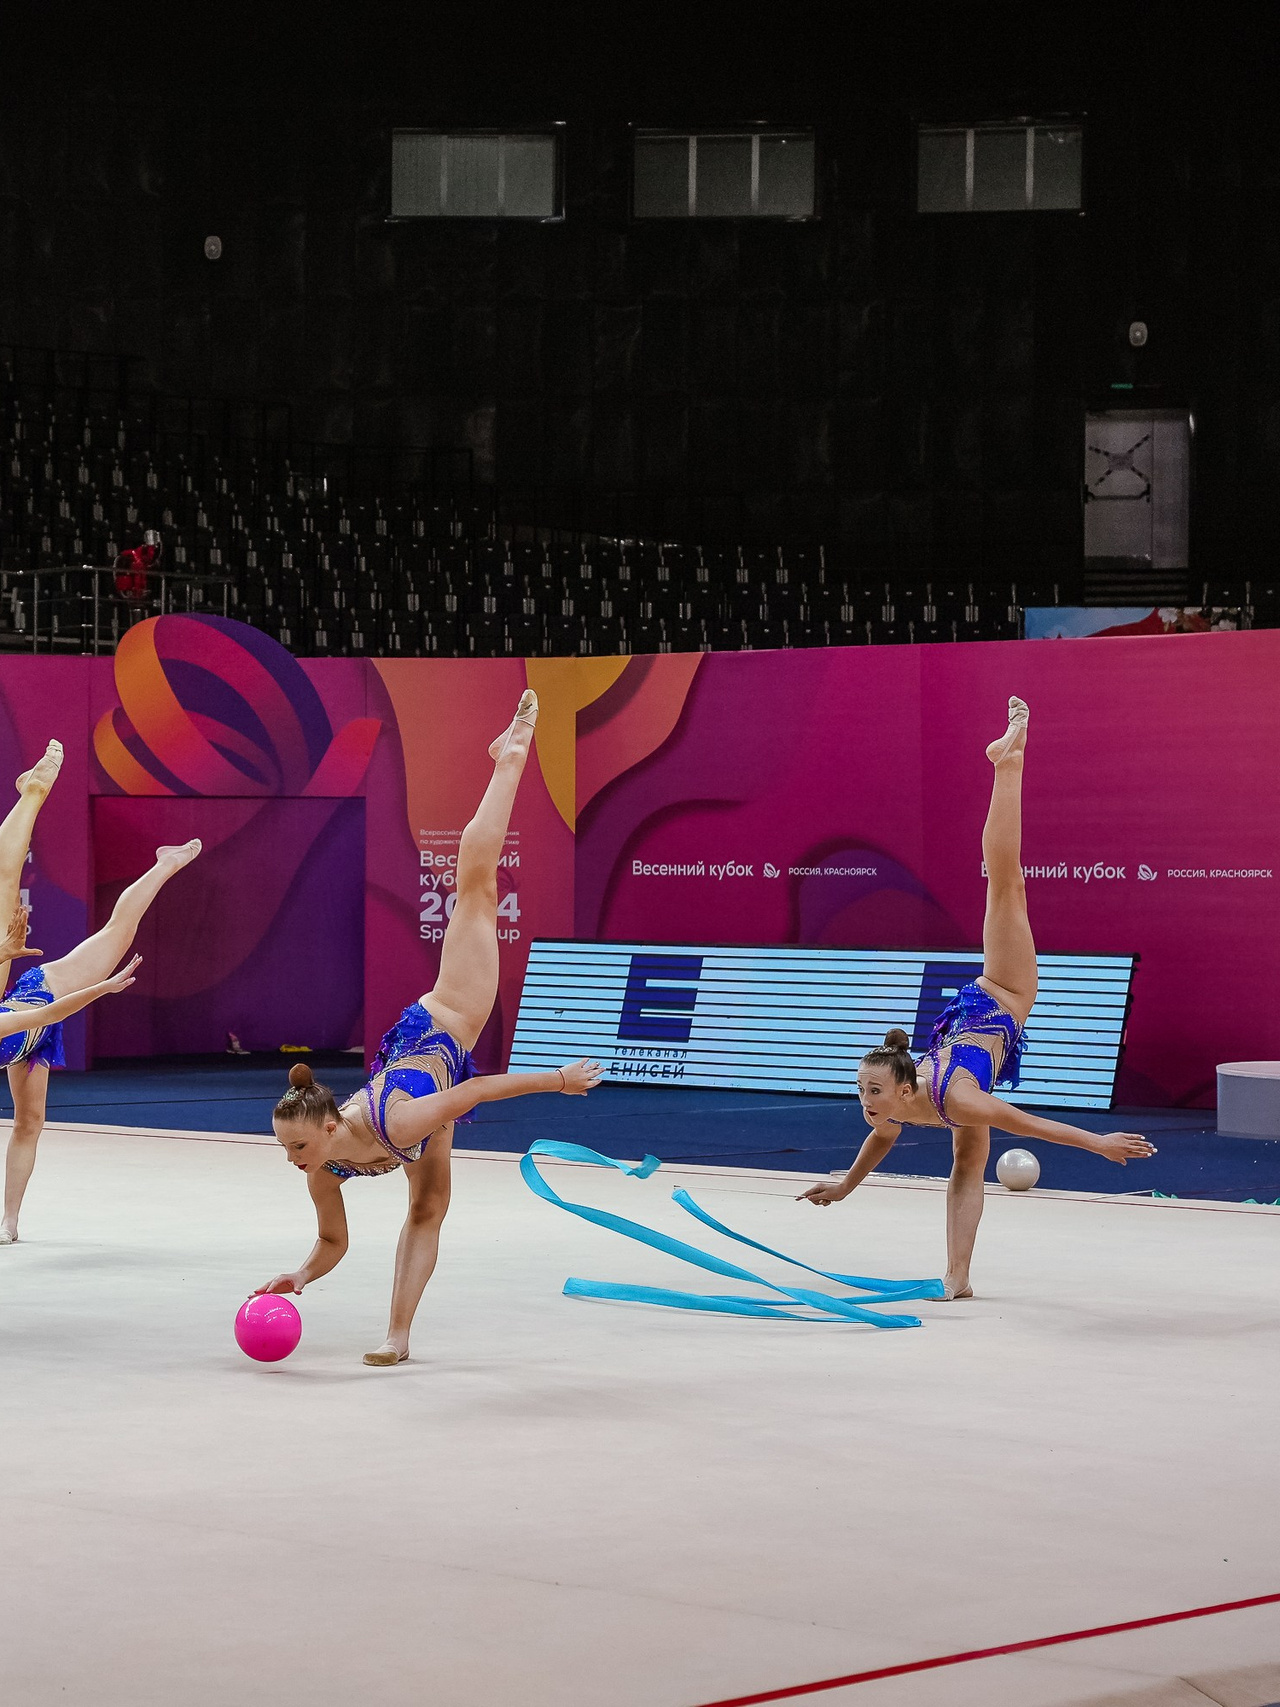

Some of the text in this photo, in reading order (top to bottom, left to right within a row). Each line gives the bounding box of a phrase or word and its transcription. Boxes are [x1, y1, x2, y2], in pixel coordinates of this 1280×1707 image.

[419, 869, 459, 891] куб
[632, 860, 877, 881] Весенний кубок РОССИЯ, КРАСНОЯРСК
[1073, 861, 1126, 883] кубок
[1167, 868, 1208, 880] РОССИЯ,
[1209, 868, 1273, 879] КРАСНОЯРСК
[613, 1046, 688, 1060] телеканал
[609, 1061, 686, 1080] ЕНИСЕЙ
